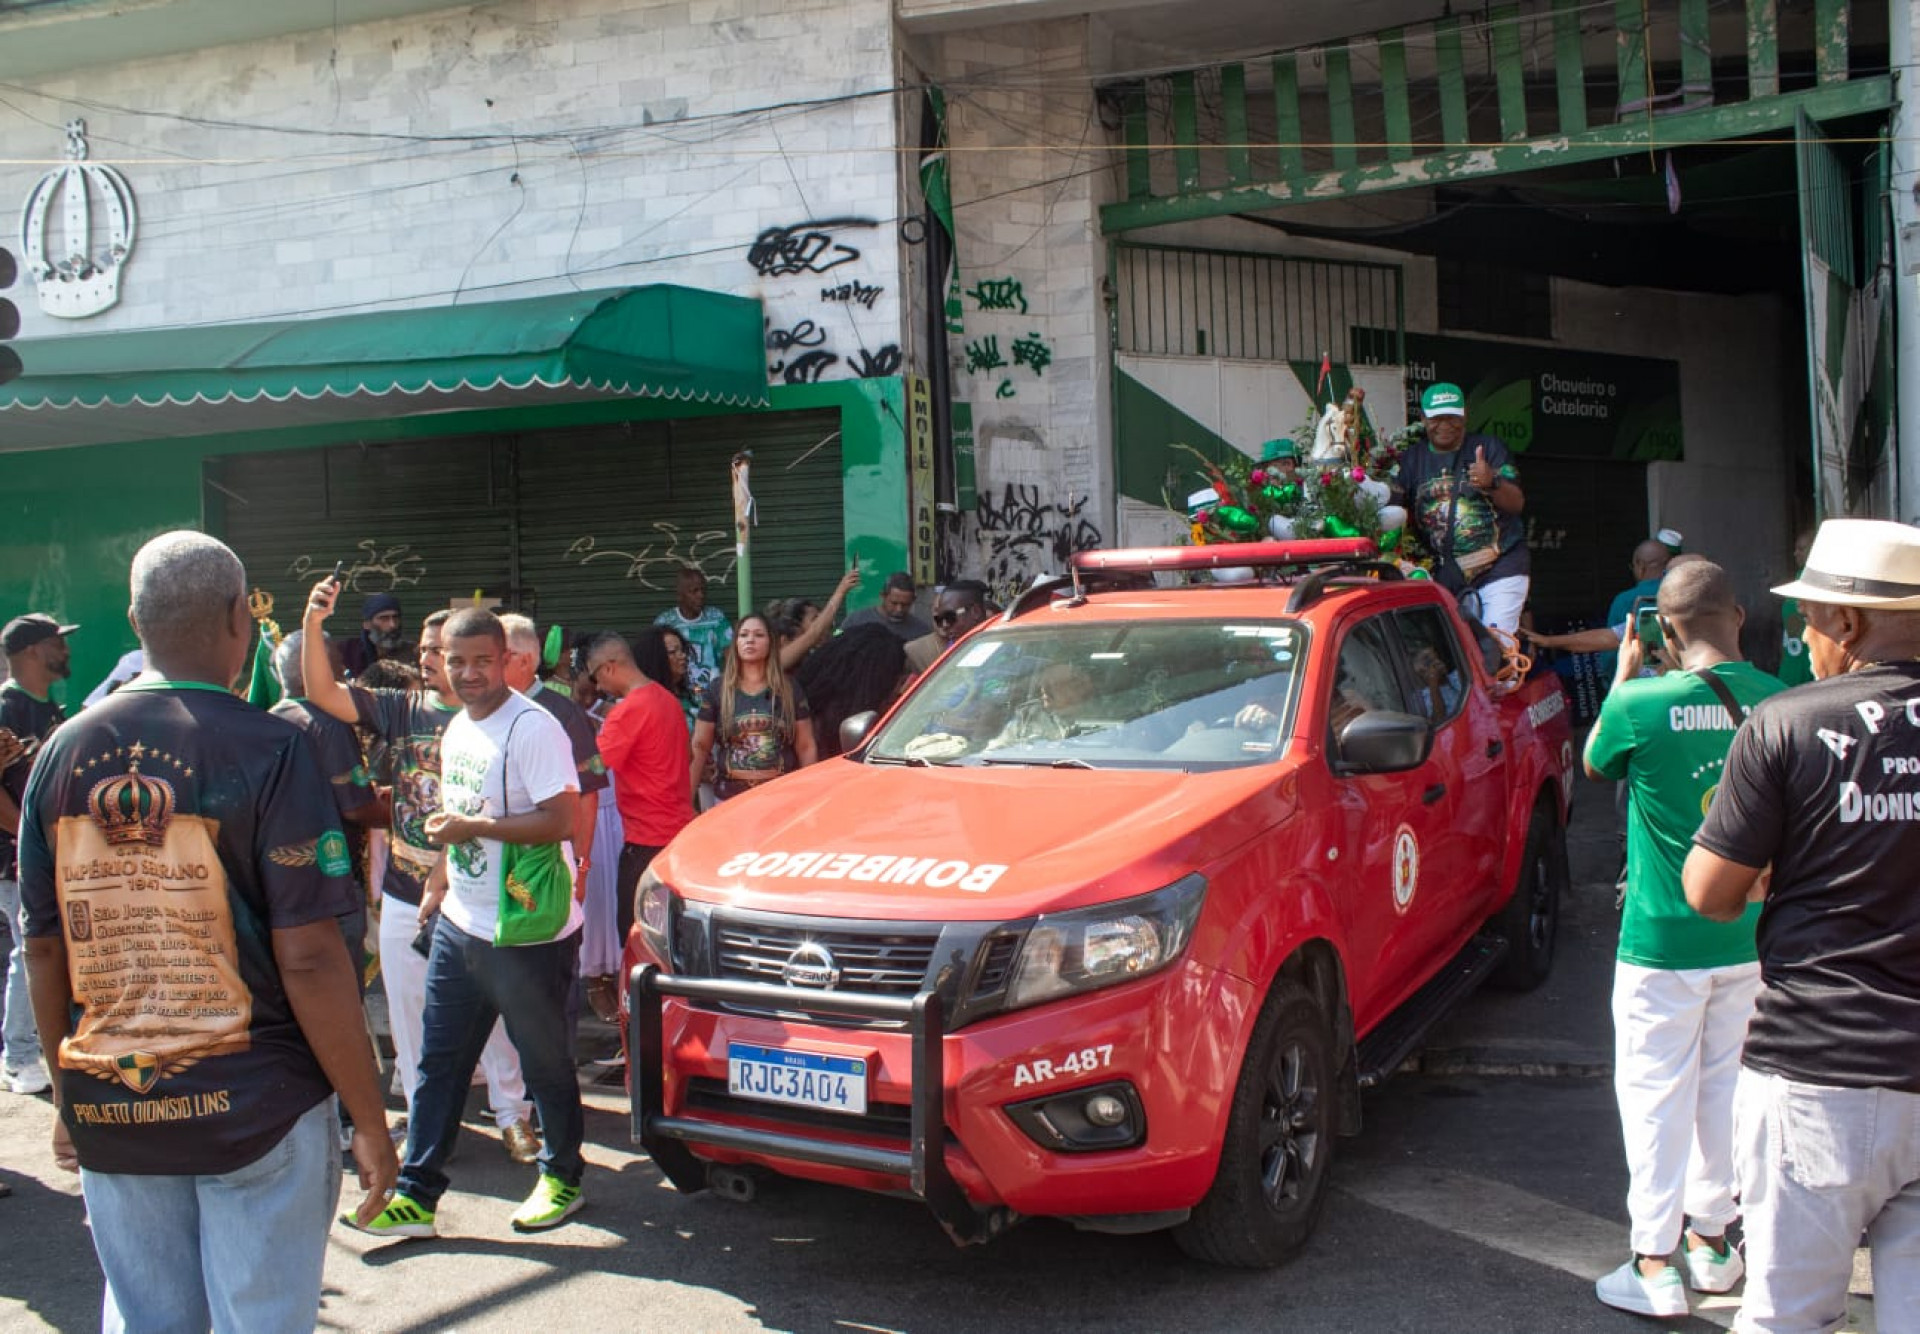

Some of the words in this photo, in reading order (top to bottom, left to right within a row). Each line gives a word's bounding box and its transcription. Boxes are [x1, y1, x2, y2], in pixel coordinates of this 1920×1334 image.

[1540, 373, 1606, 395] Chaveiro
[1606, 384, 1616, 397] e
[1542, 396, 1608, 418] Cutelaria
[918, 506, 931, 581] AQUI
[740, 1061, 848, 1105] RJC3A04
[1013, 1044, 1113, 1087] AR-487
[73, 1103, 131, 1124] PROJETO
[194, 1090, 231, 1117] LINS
